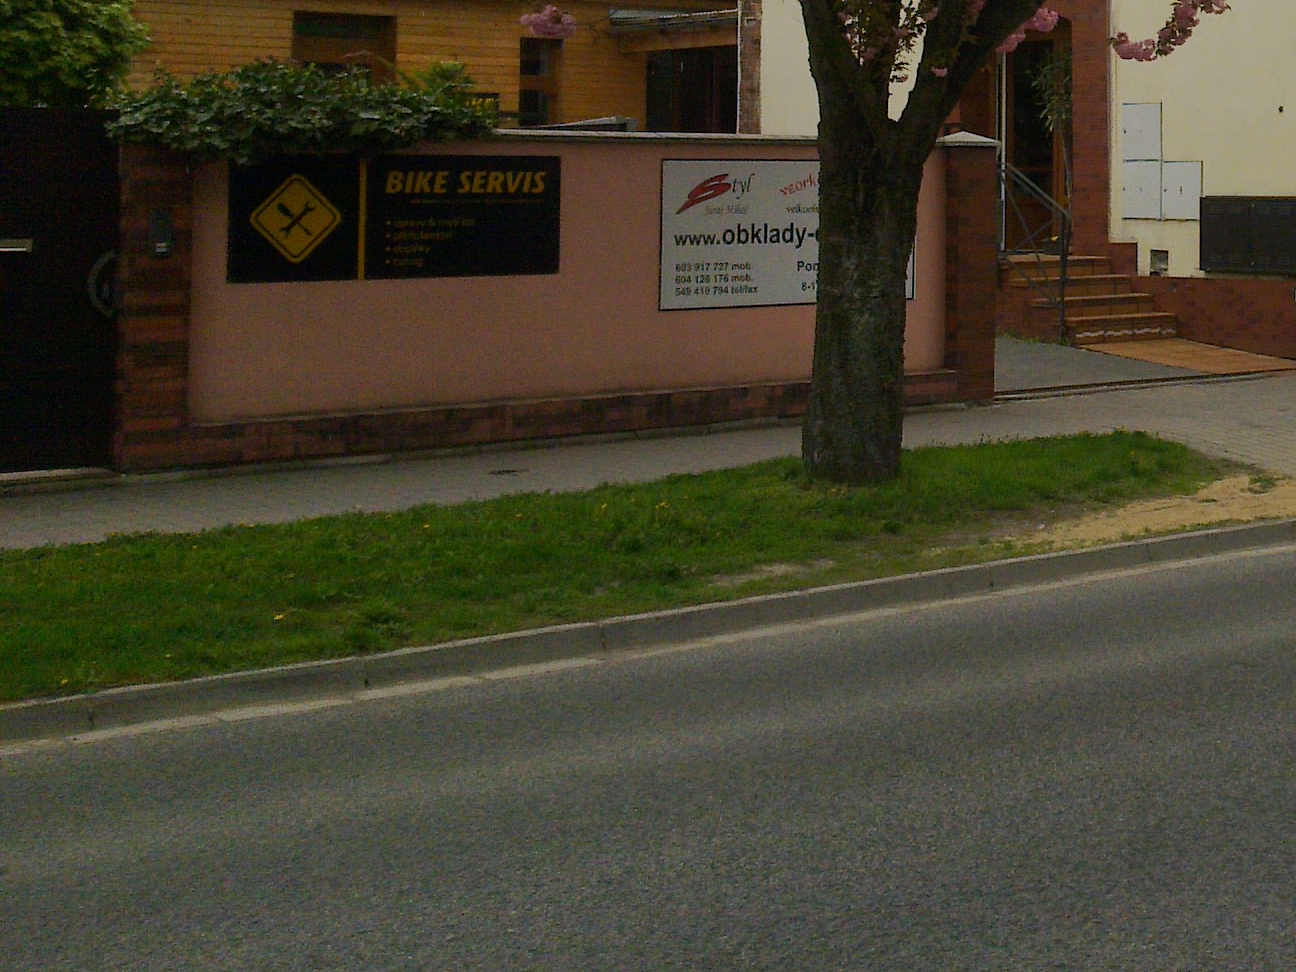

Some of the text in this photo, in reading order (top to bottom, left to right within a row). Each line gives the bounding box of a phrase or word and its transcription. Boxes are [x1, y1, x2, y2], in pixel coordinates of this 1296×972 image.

[385, 170, 546, 194] BIKE SERVIS
[713, 261, 729, 271] 727
